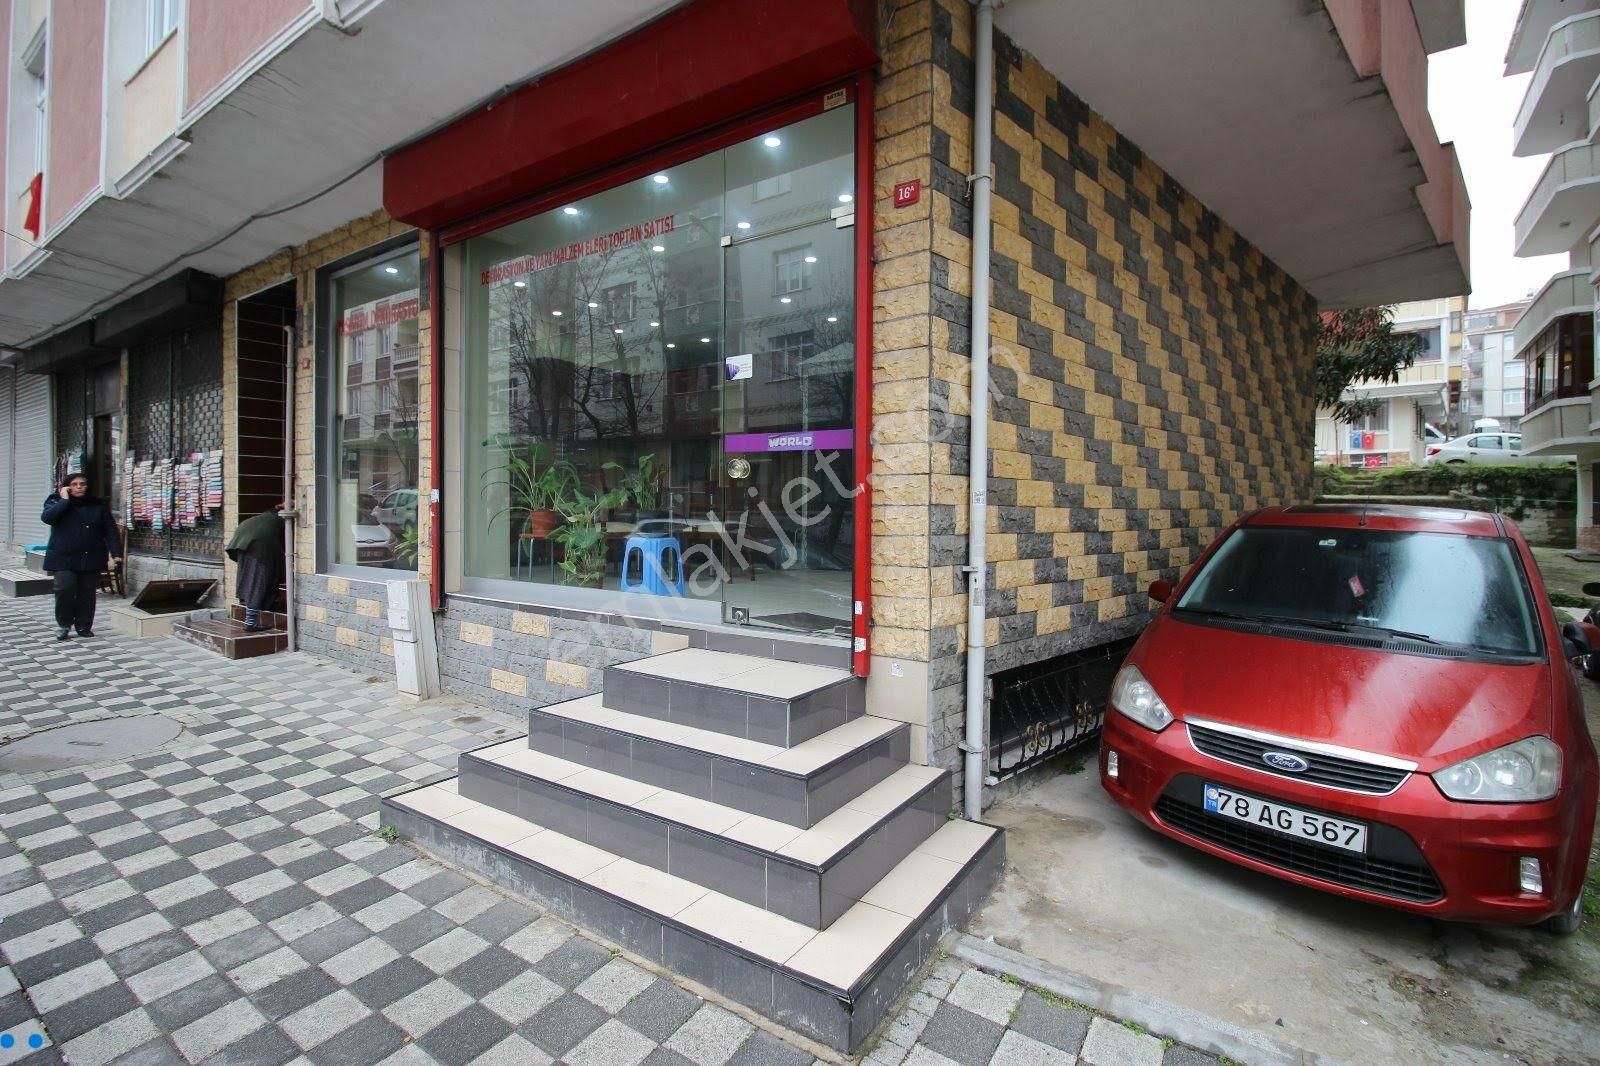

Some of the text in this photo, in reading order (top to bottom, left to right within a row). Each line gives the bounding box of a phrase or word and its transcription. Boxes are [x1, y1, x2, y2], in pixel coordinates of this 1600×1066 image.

[898, 185, 915, 201] 16A
[608, 225, 642, 248] TOPTAN
[768, 436, 813, 448] WORLD
[1271, 754, 1298, 769] Ford
[1207, 791, 1360, 846] TR 78 AG 567
